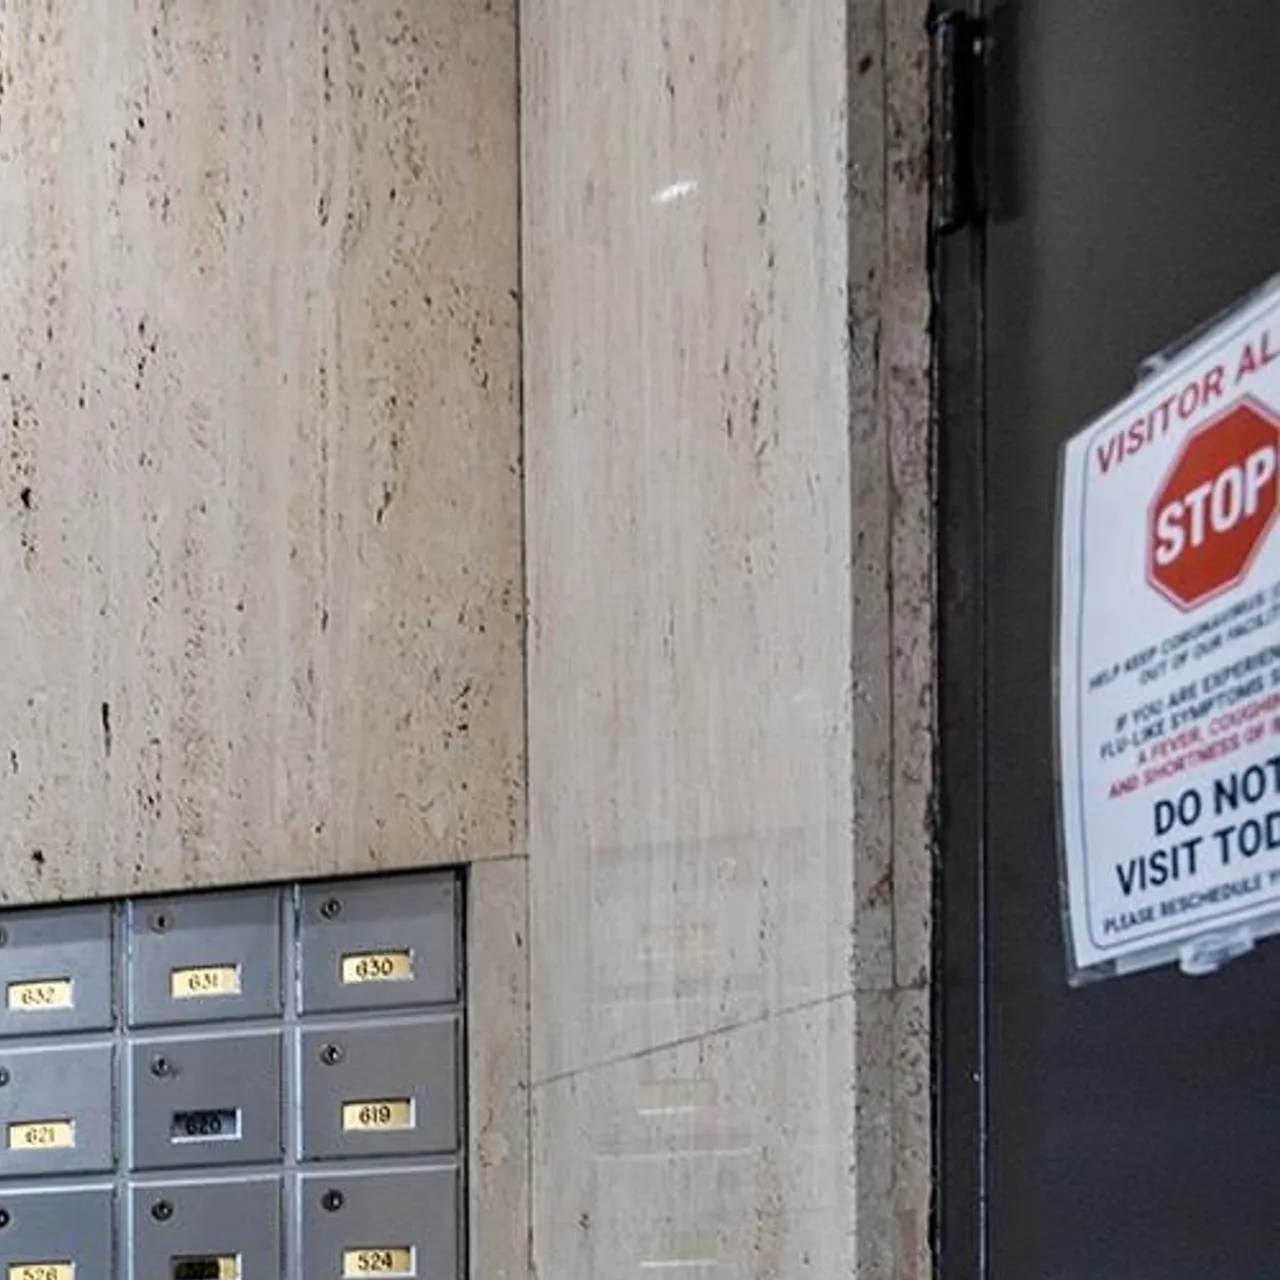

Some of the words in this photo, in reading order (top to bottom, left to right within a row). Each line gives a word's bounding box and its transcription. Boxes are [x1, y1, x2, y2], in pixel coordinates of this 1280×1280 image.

[1096, 363, 1225, 474] VISITOR
[1155, 445, 1276, 566] STOP
[1124, 646, 1157, 673] KEEP
[1140, 658, 1167, 685] OUT
[1171, 650, 1189, 670] OF
[1193, 633, 1223, 661] OUR
[1100, 717, 1164, 760] FLU-LIKE
[1171, 675, 1264, 731] SYMPTOMS
[1132, 700, 1164, 724] YOU
[1168, 681, 1197, 708] ARE
[1108, 774, 1140, 799] AND
[1144, 733, 1240, 788] SHORTNESS
[1244, 722, 1265, 746] OF
[1154, 788, 1202, 837] DO
[1116, 836, 1204, 897] VISIT
[1103, 904, 1154, 935] PLEASE
[1160, 871, 1261, 917] RESCHEDULE
[189, 973, 218, 990] 631
[356, 958, 393, 977] 630
[22, 987, 55, 1004] 632
[25, 1127, 55, 1144] 621
[186, 1114, 221, 1134] 620
[359, 1106, 391, 1124] 619
[358, 1252, 392, 1270] 524
